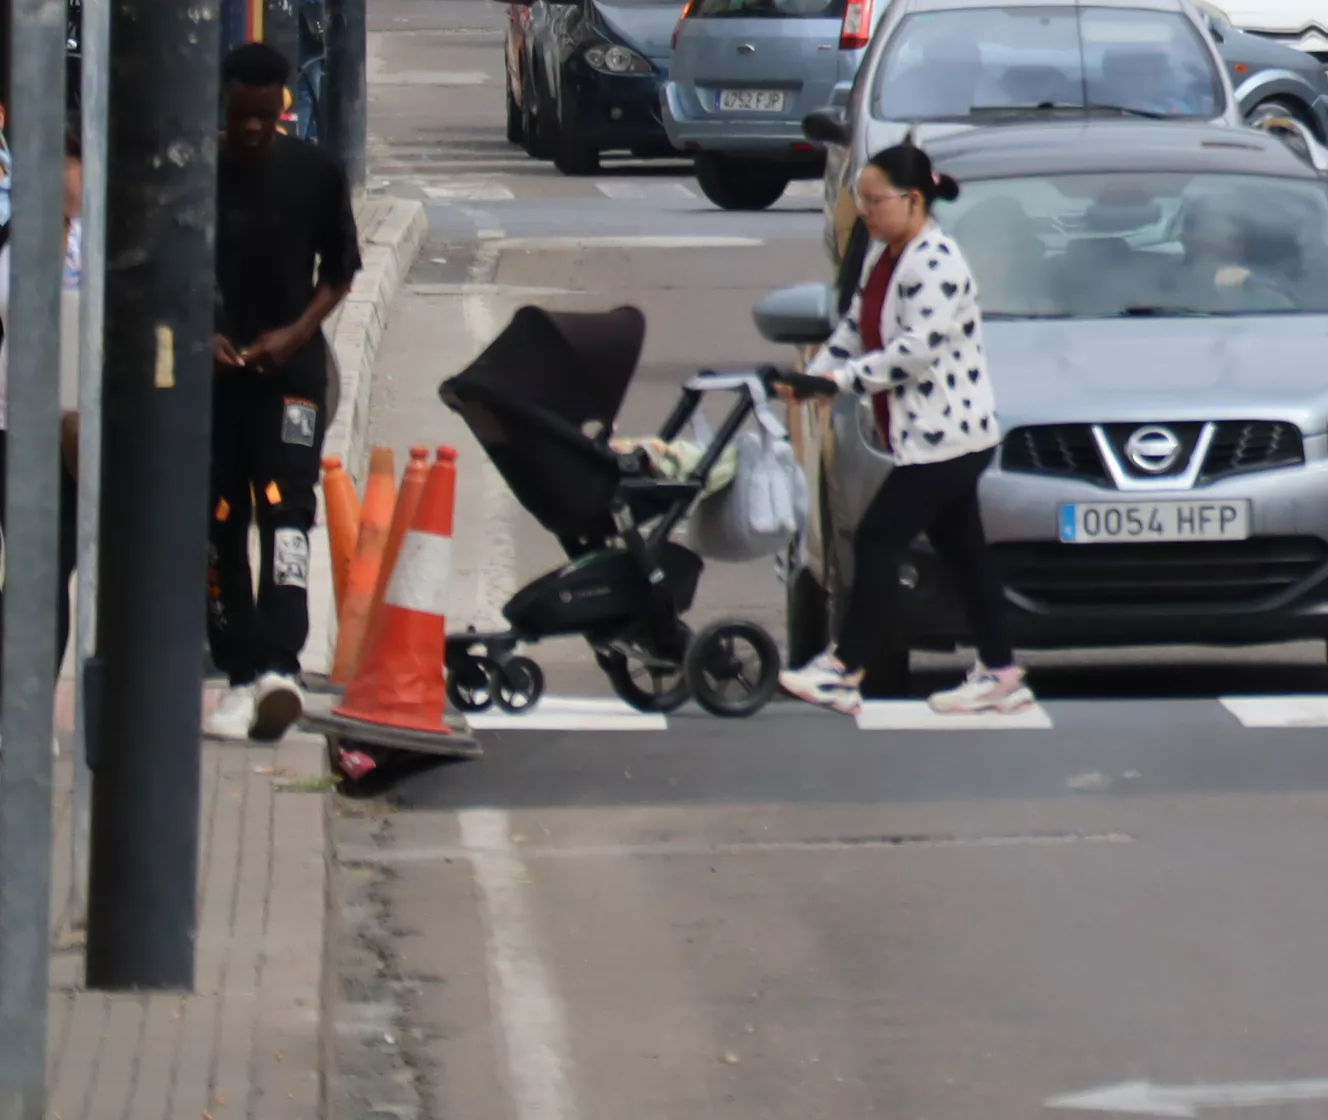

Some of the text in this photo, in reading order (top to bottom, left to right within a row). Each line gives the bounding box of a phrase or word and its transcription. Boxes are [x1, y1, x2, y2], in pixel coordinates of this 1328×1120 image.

[724, 92, 752, 109] 4752
[1083, 506, 1237, 536] 0054 HFP
